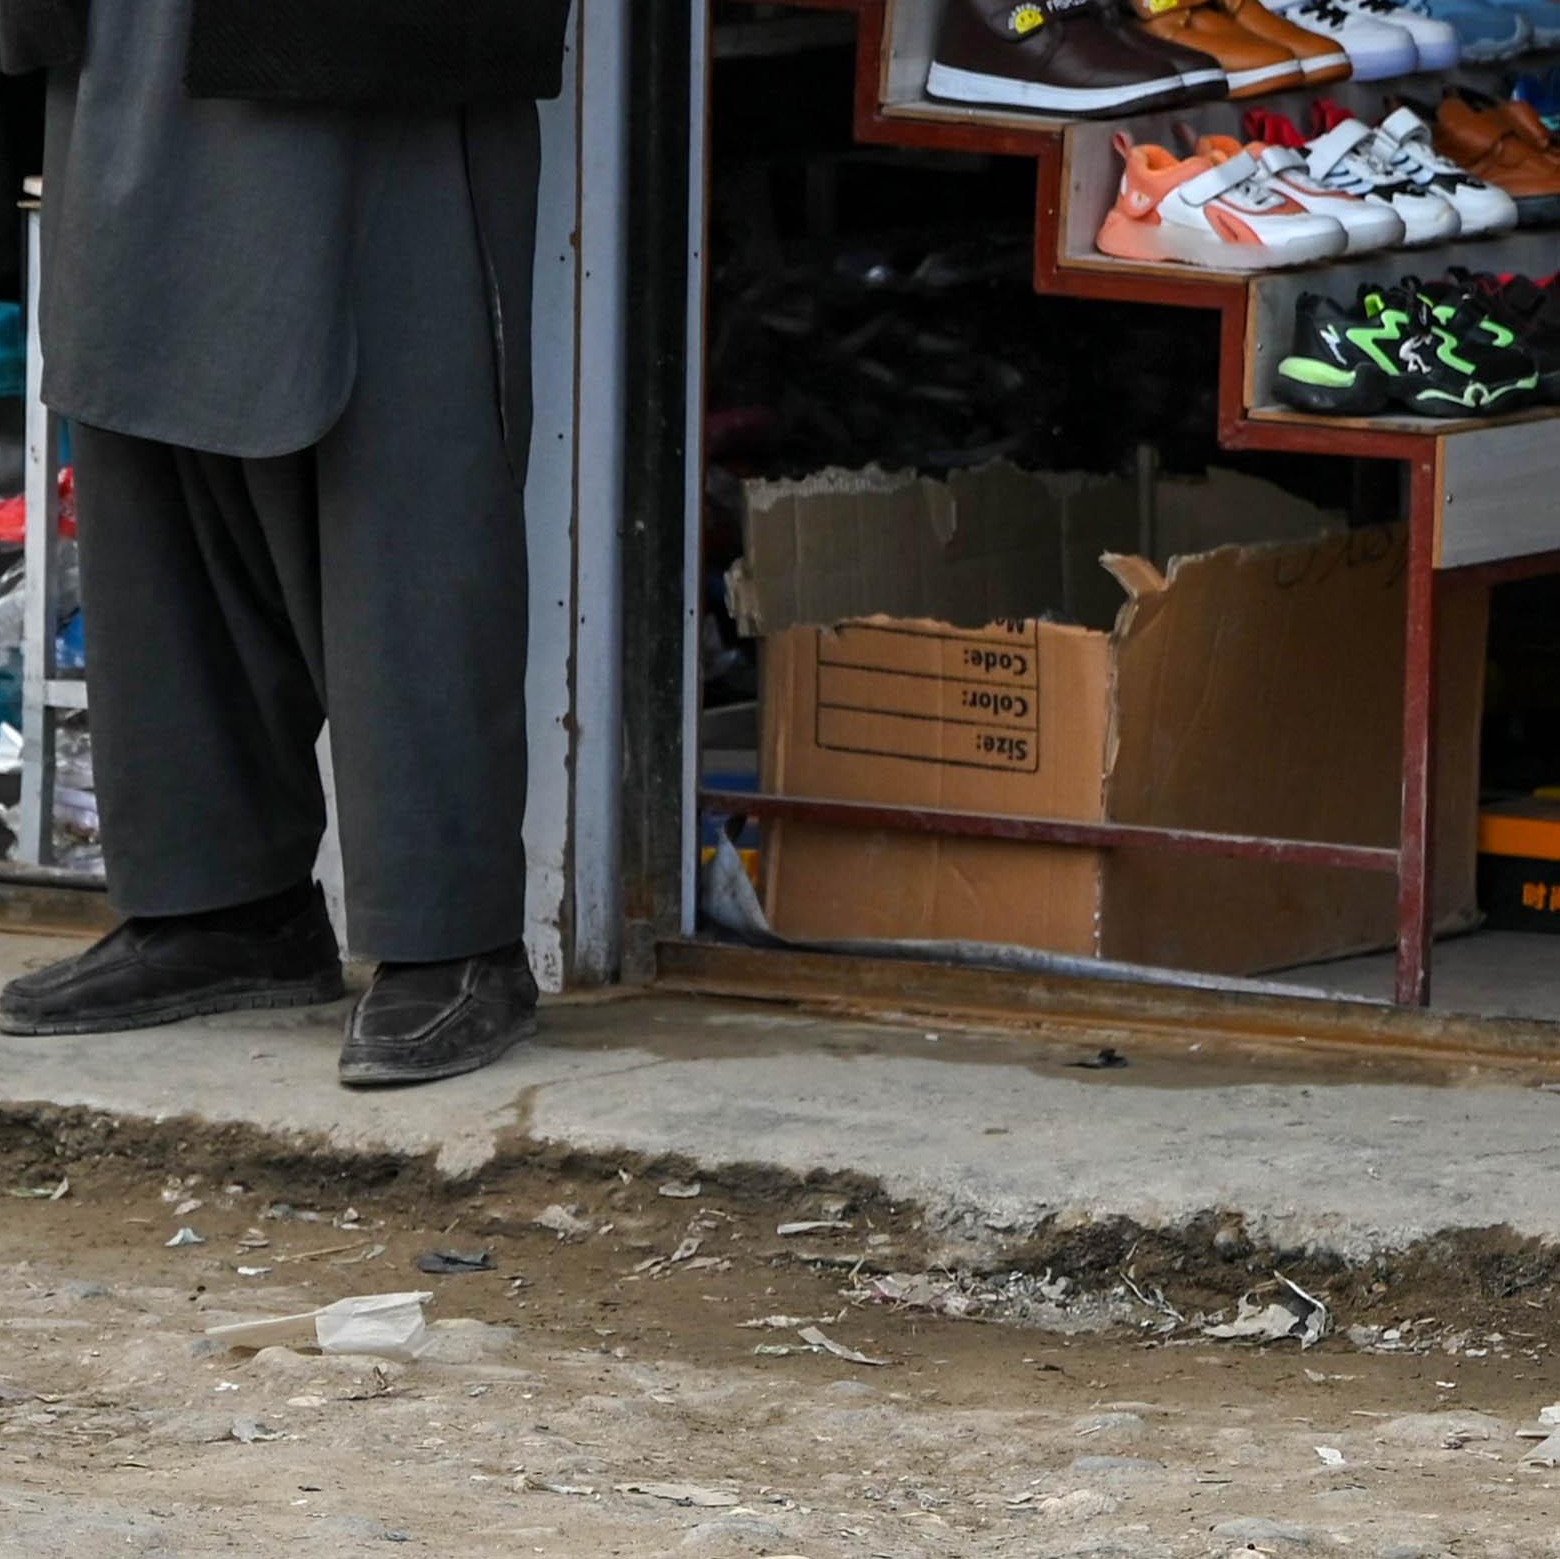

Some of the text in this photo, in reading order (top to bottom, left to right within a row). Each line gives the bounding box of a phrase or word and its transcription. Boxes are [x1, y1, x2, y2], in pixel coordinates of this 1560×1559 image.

[963, 648, 1028, 677] Code:
[962, 690, 1029, 718] Color:
[977, 734, 1028, 761] Size:
